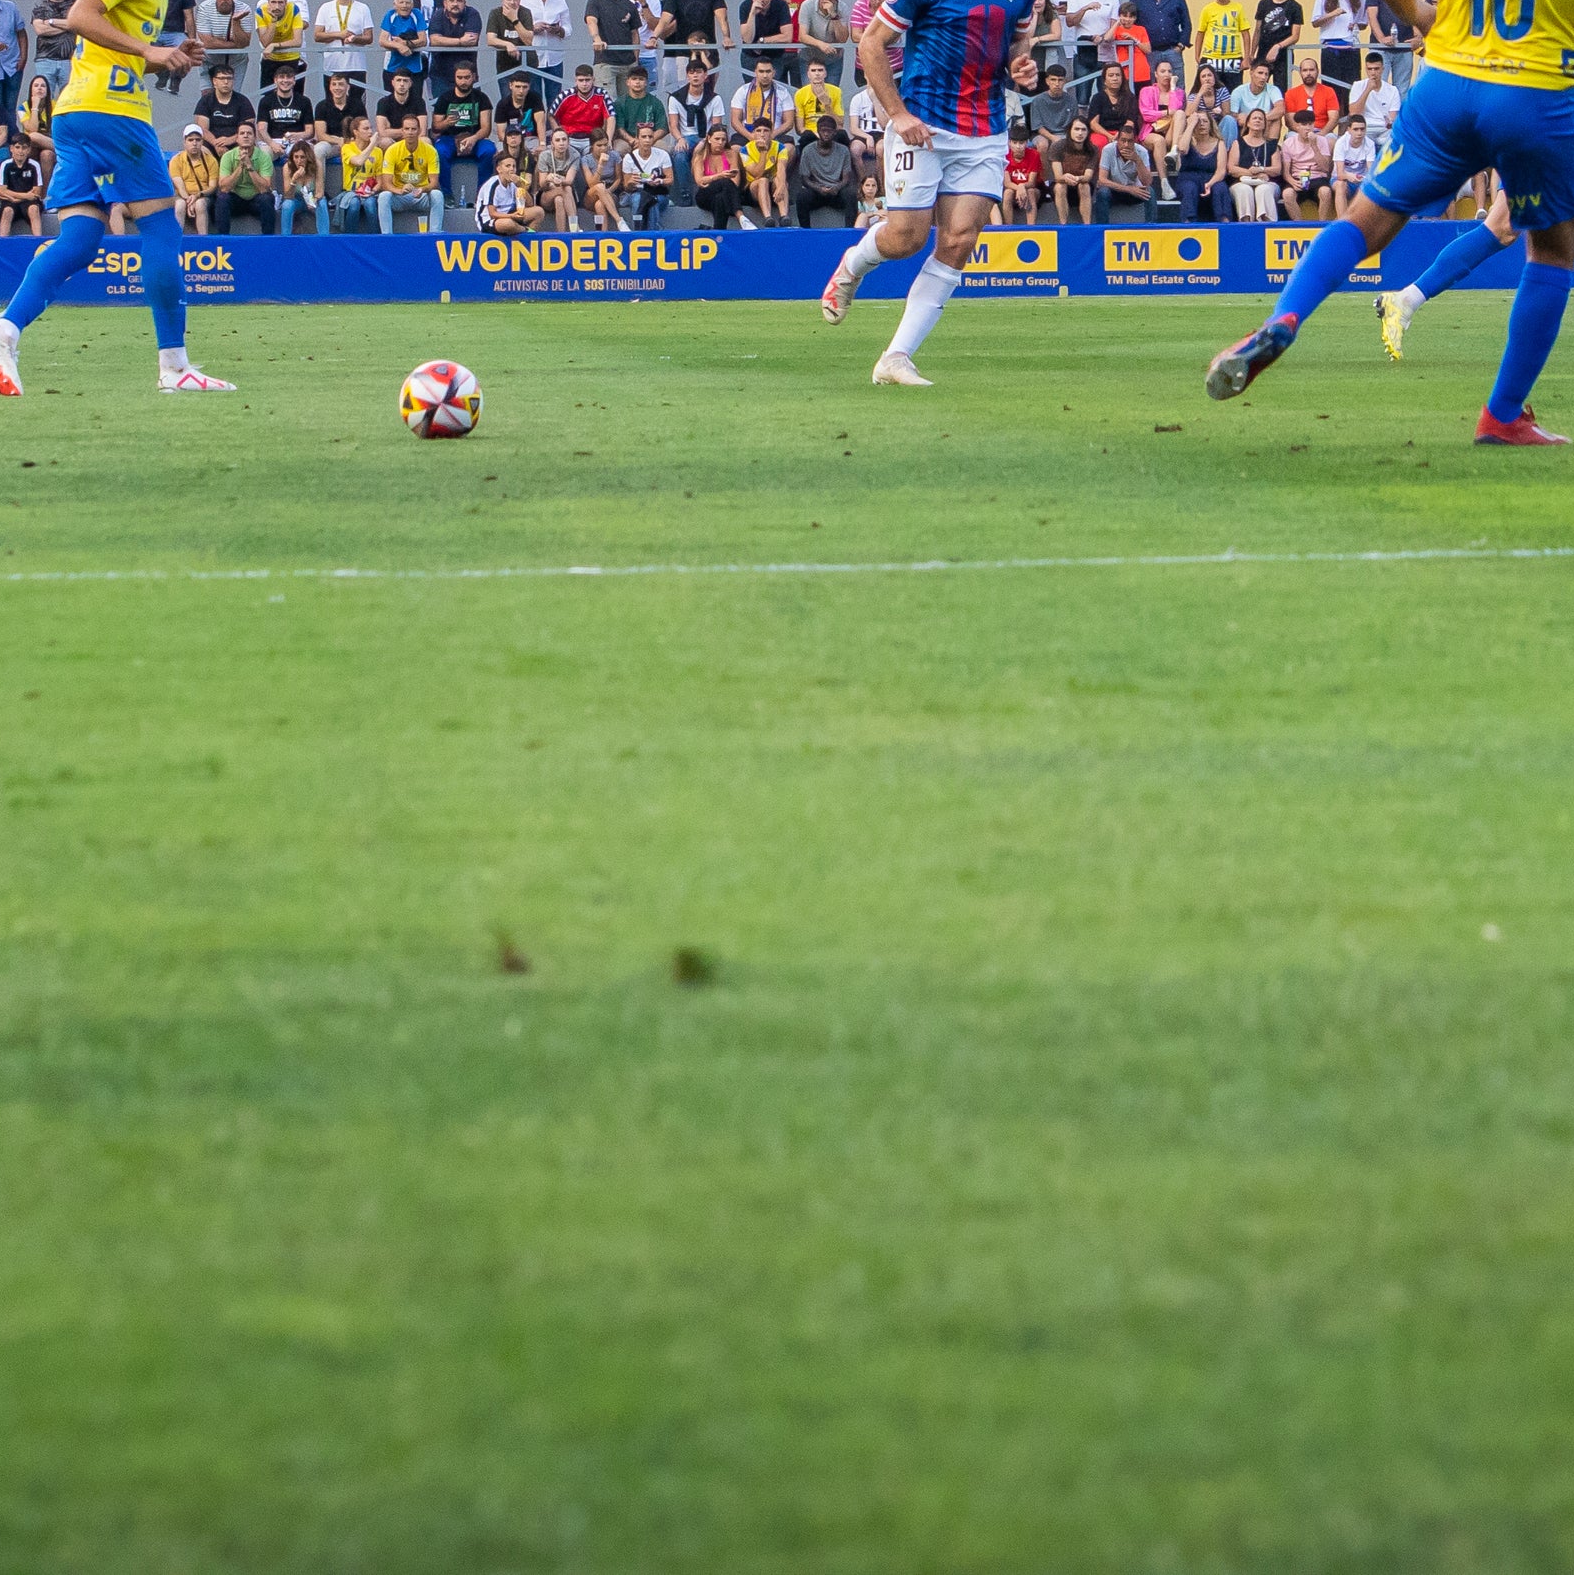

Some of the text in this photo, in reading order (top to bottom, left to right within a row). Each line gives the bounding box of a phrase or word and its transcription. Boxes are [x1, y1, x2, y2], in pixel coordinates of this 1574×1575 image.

[1206, 58, 1241, 74] NIKE
[895, 150, 914, 173] 20
[1112, 241, 1150, 263] TM
[184, 274, 235, 283] CONFIANZA
[494, 278, 665, 292] ACTIVISTAS DE LA SOSTENIBILIDAD
[965, 276, 1060, 289] Real Estate Group
[1106, 274, 1221, 287] TM Real Estate Group
[1267, 274, 1285, 284] TM
[1348, 273, 1383, 285] Group
[106, 286, 126, 294] CLS
